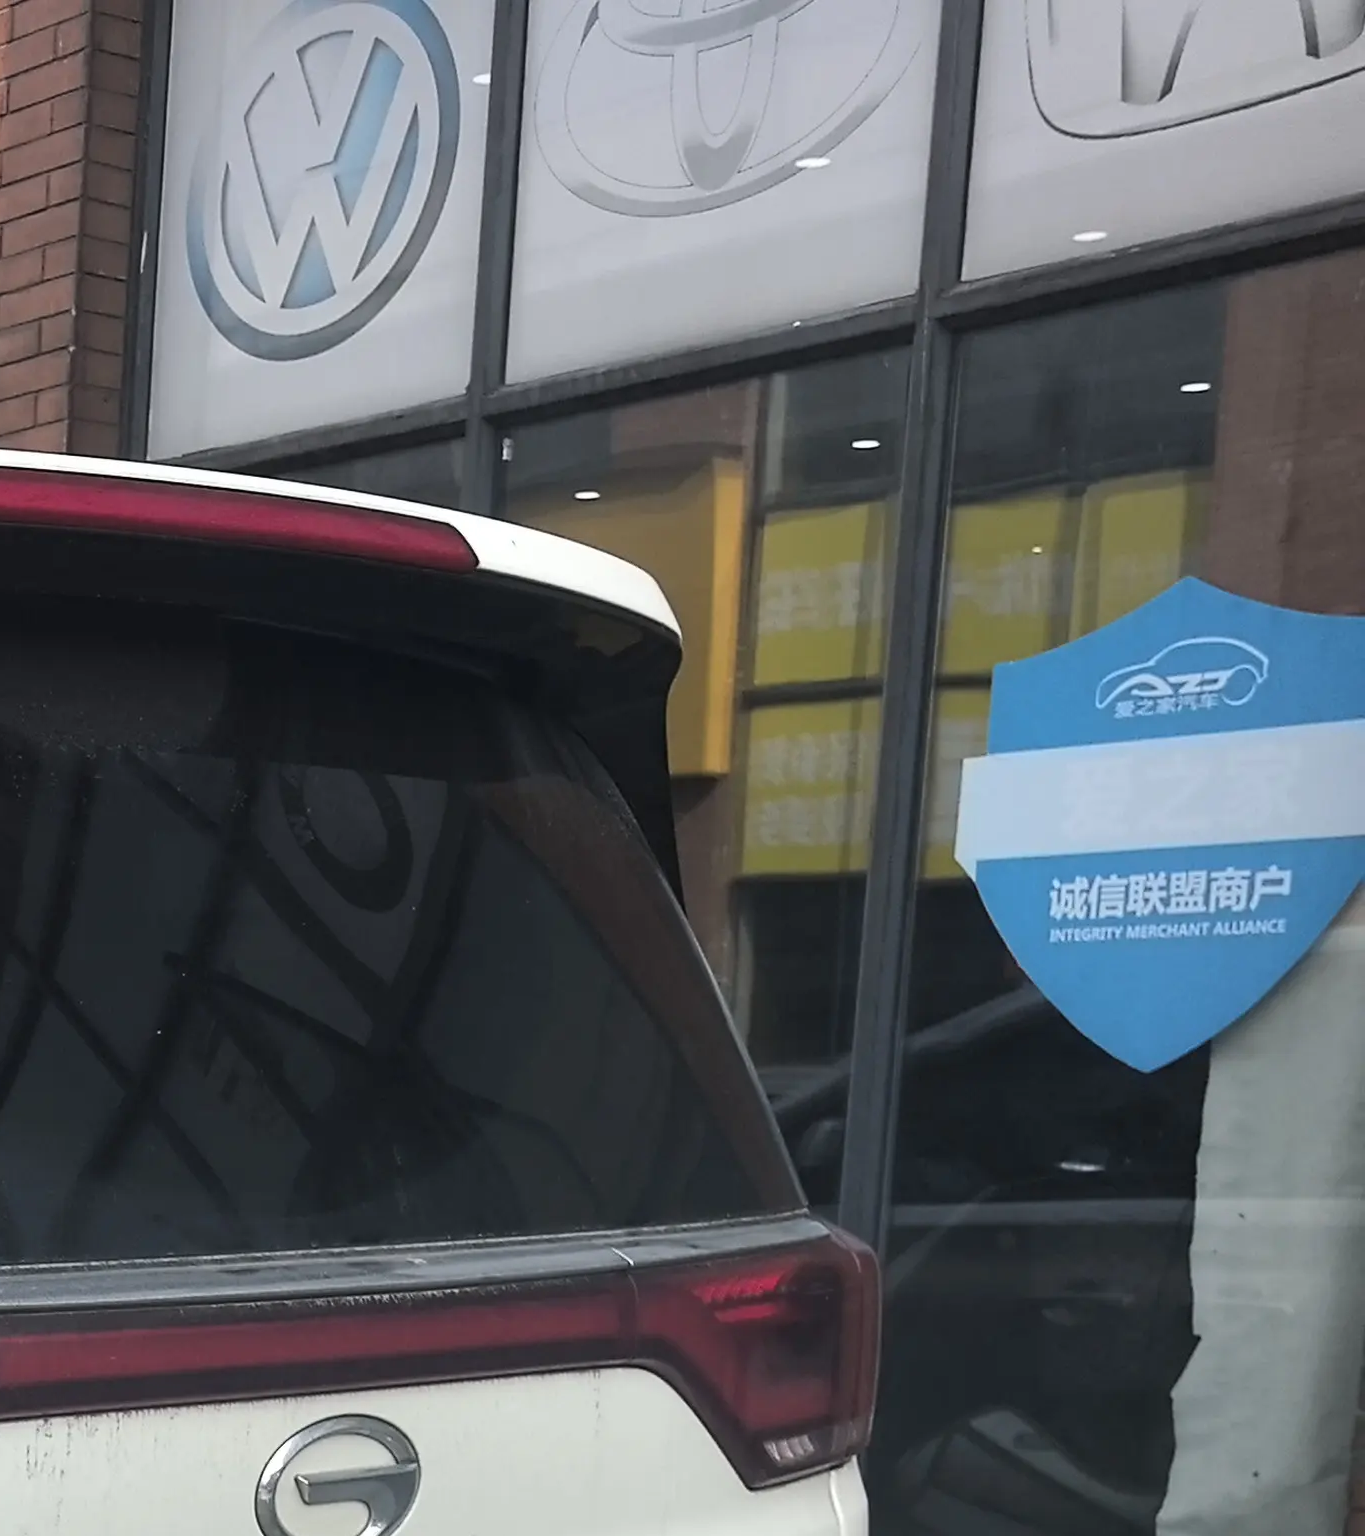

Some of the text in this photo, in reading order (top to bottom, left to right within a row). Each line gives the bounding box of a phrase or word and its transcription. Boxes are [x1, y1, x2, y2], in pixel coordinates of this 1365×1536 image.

[1114, 691, 1220, 719] 爱之家汽车
[1049, 864, 1292, 921] 诚信联盟商户
[1049, 918, 1287, 943] INTEGRITY MERCHANT ALLIANCE
